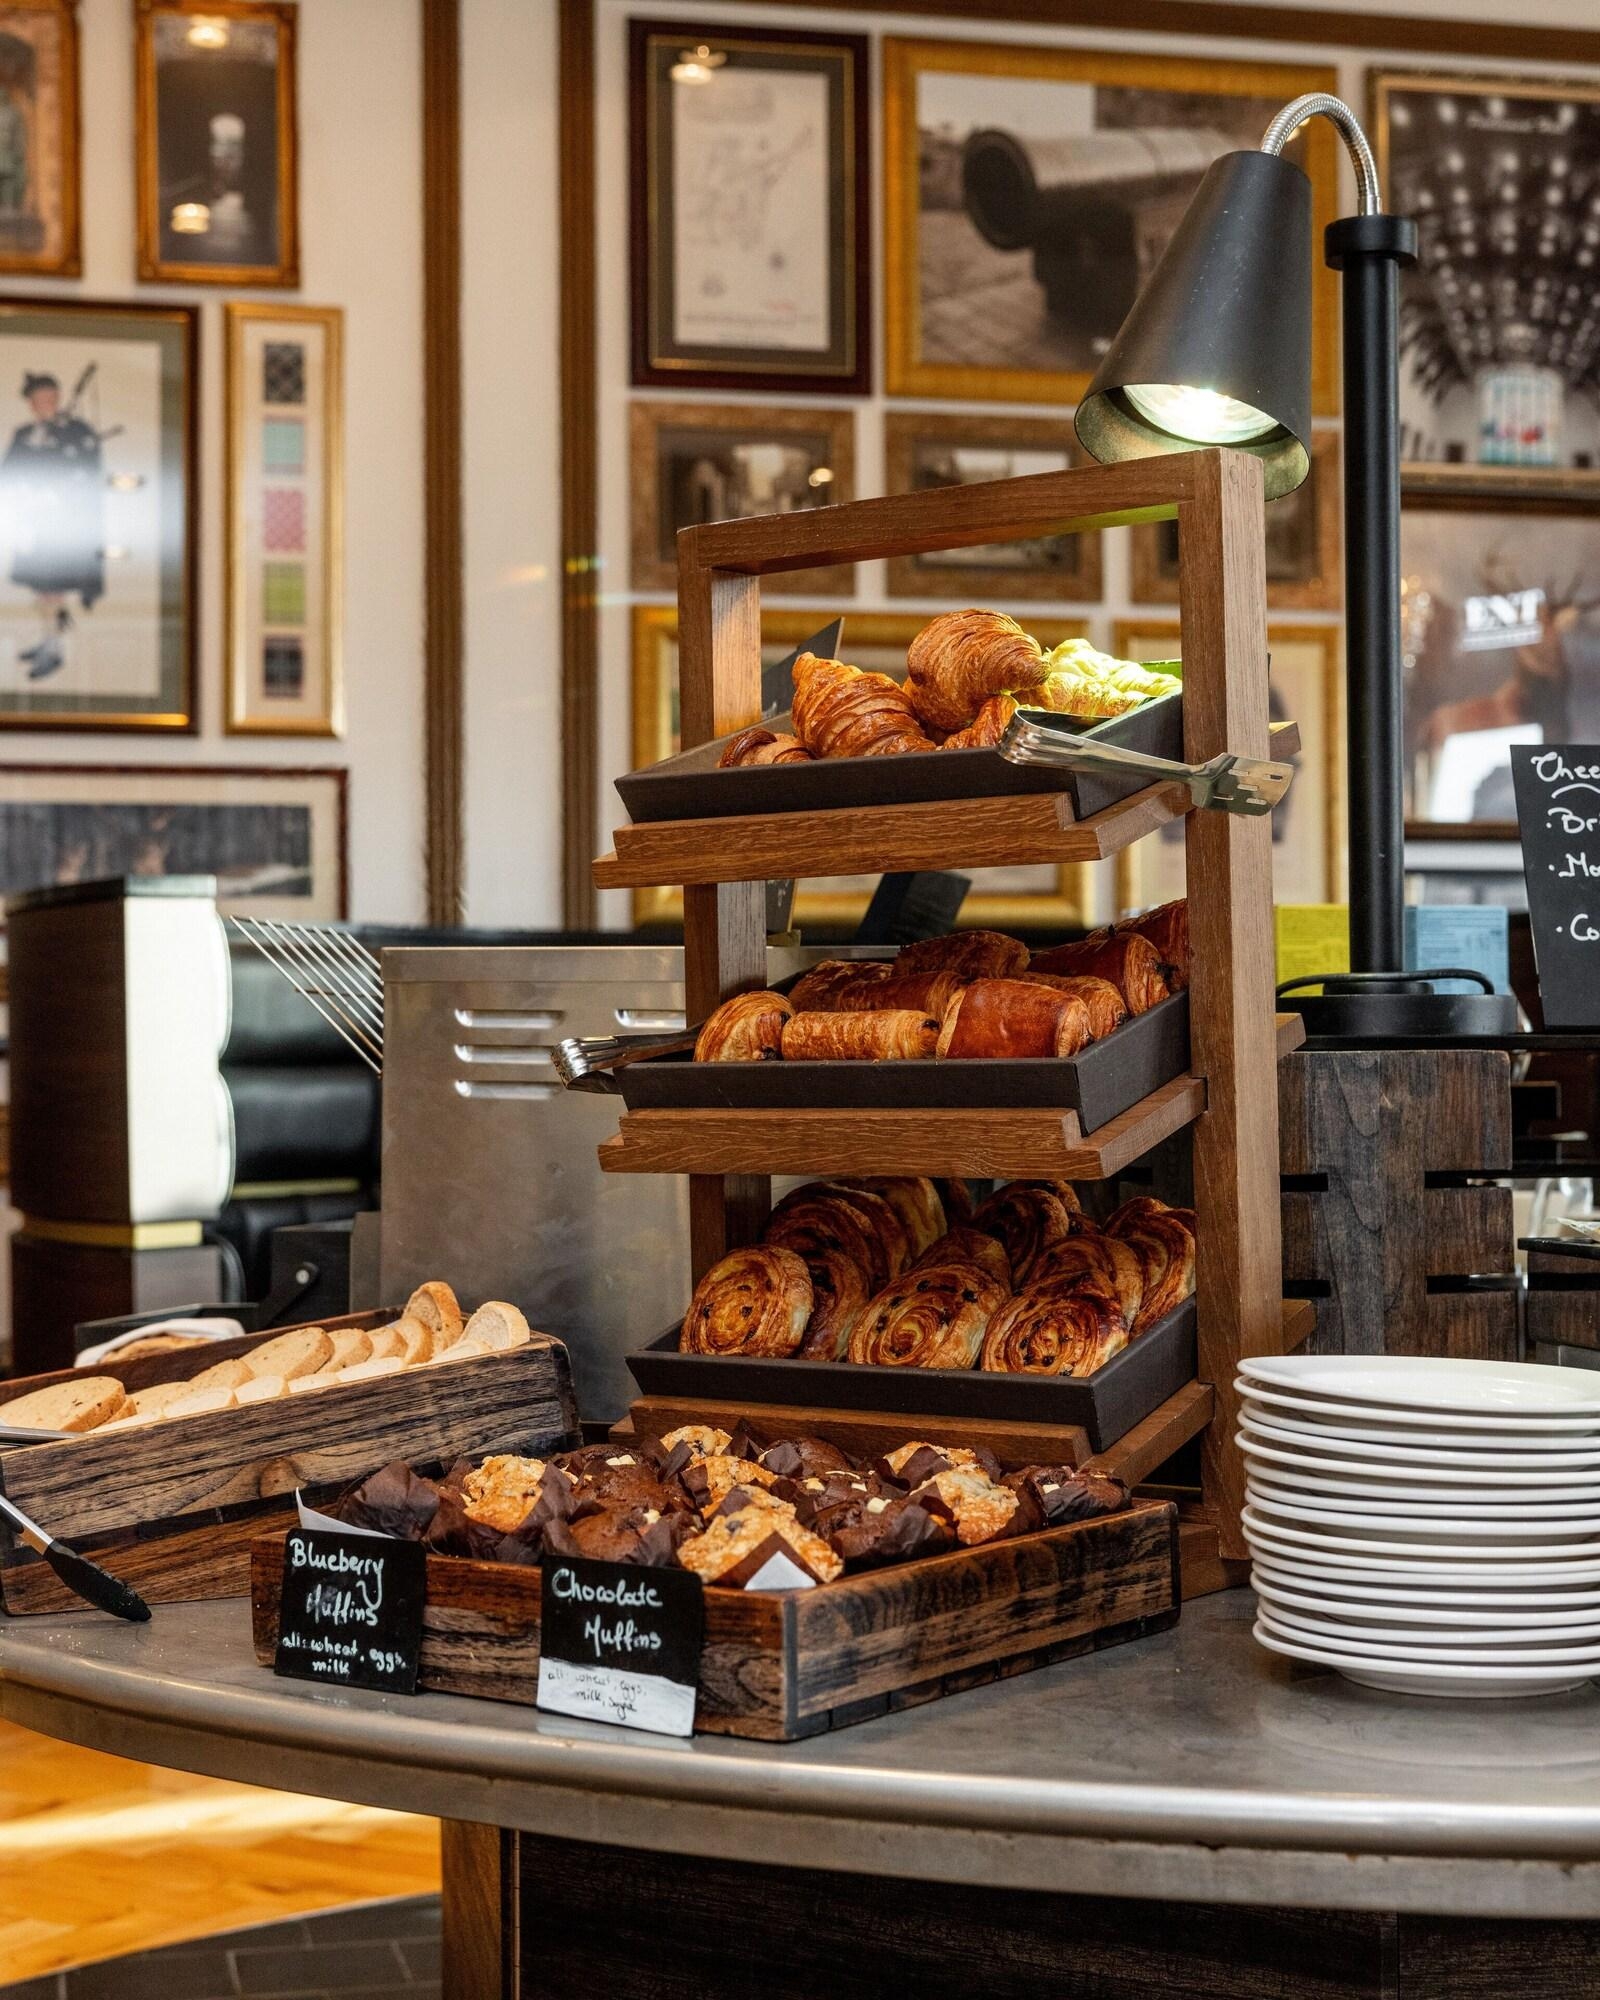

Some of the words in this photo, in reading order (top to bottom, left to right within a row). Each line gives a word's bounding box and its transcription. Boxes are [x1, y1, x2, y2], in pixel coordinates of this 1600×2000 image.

[1547, 806, 1600, 834] Br
[289, 1537, 384, 1610] Blueberry
[551, 1567, 663, 1607] Chocolate
[305, 1583, 378, 1626] Muffins
[584, 1613, 662, 1658] Muffins
[311, 1658, 350, 1674] milk
